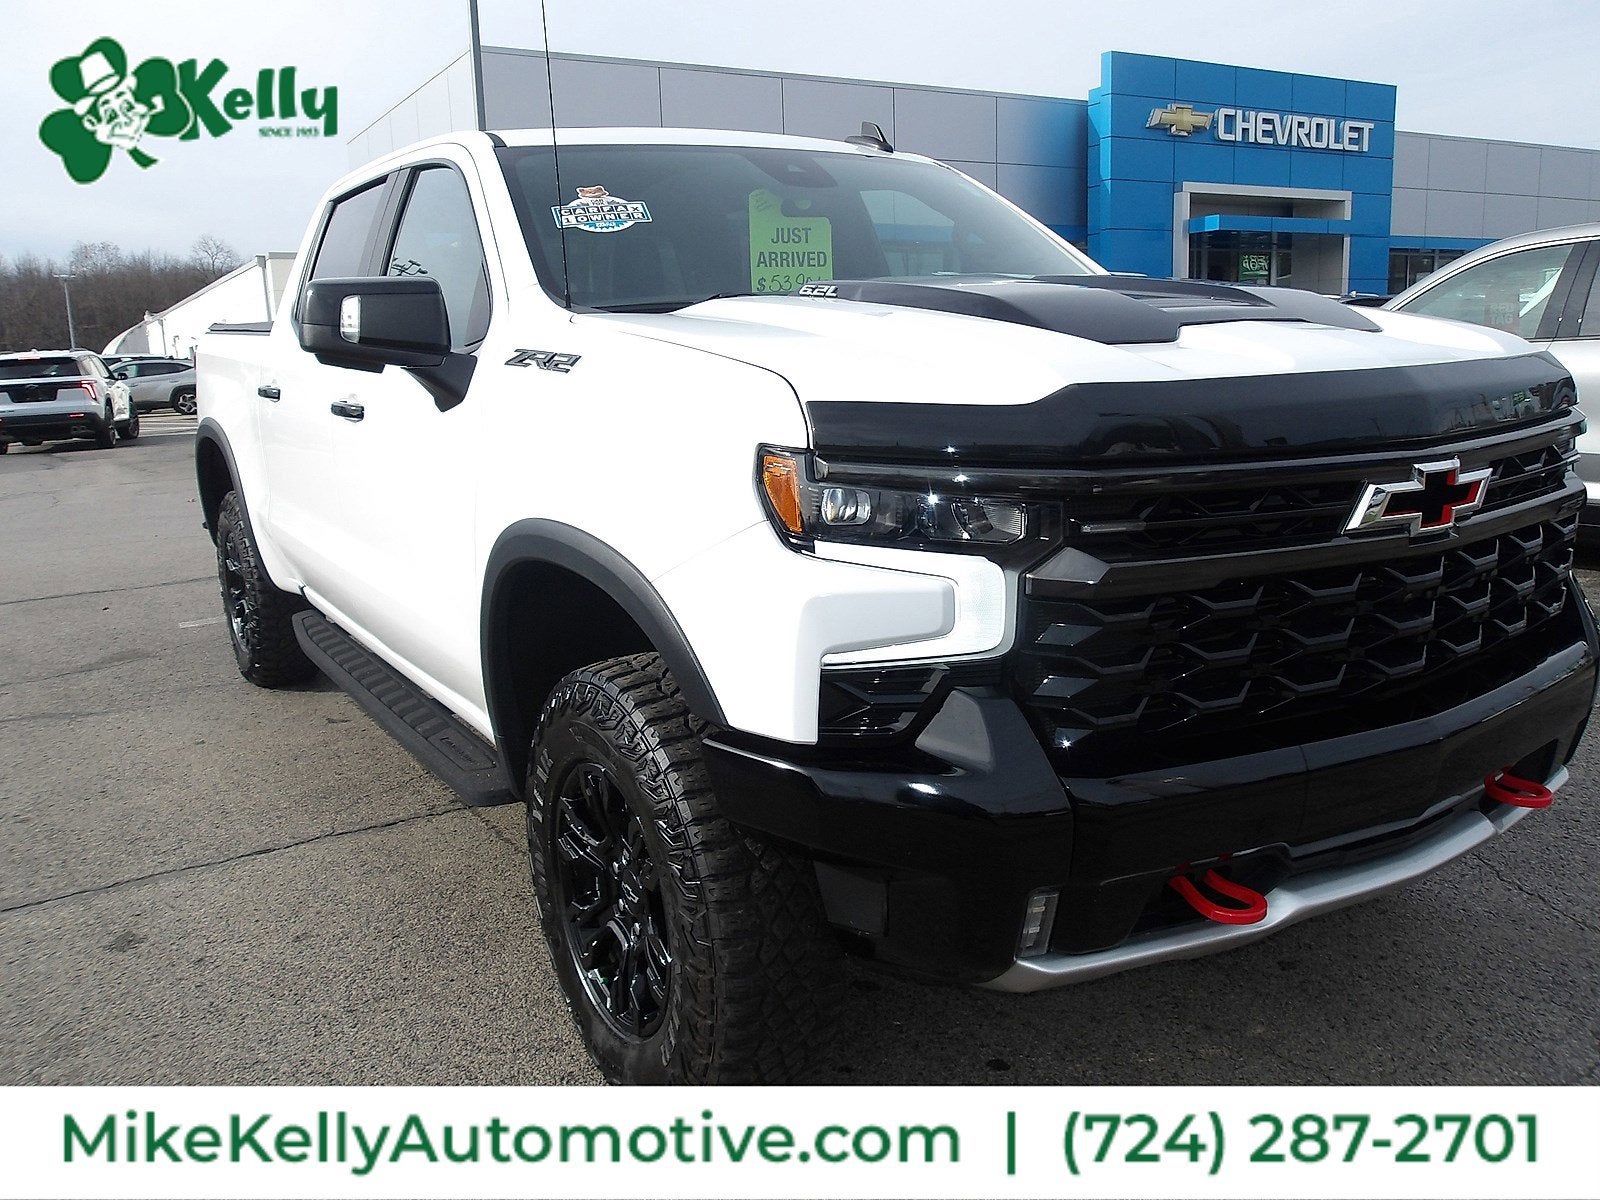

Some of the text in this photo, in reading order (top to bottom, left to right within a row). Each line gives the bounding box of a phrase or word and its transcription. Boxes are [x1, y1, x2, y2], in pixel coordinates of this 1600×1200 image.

[1217, 108, 1375, 152] CHEVROLET
[560, 205, 640, 216] CARFAX
[577, 212, 645, 222] OWNER
[771, 227, 812, 244] JUST
[757, 251, 827, 268] ARRIVED
[504, 349, 581, 373] ZR2
